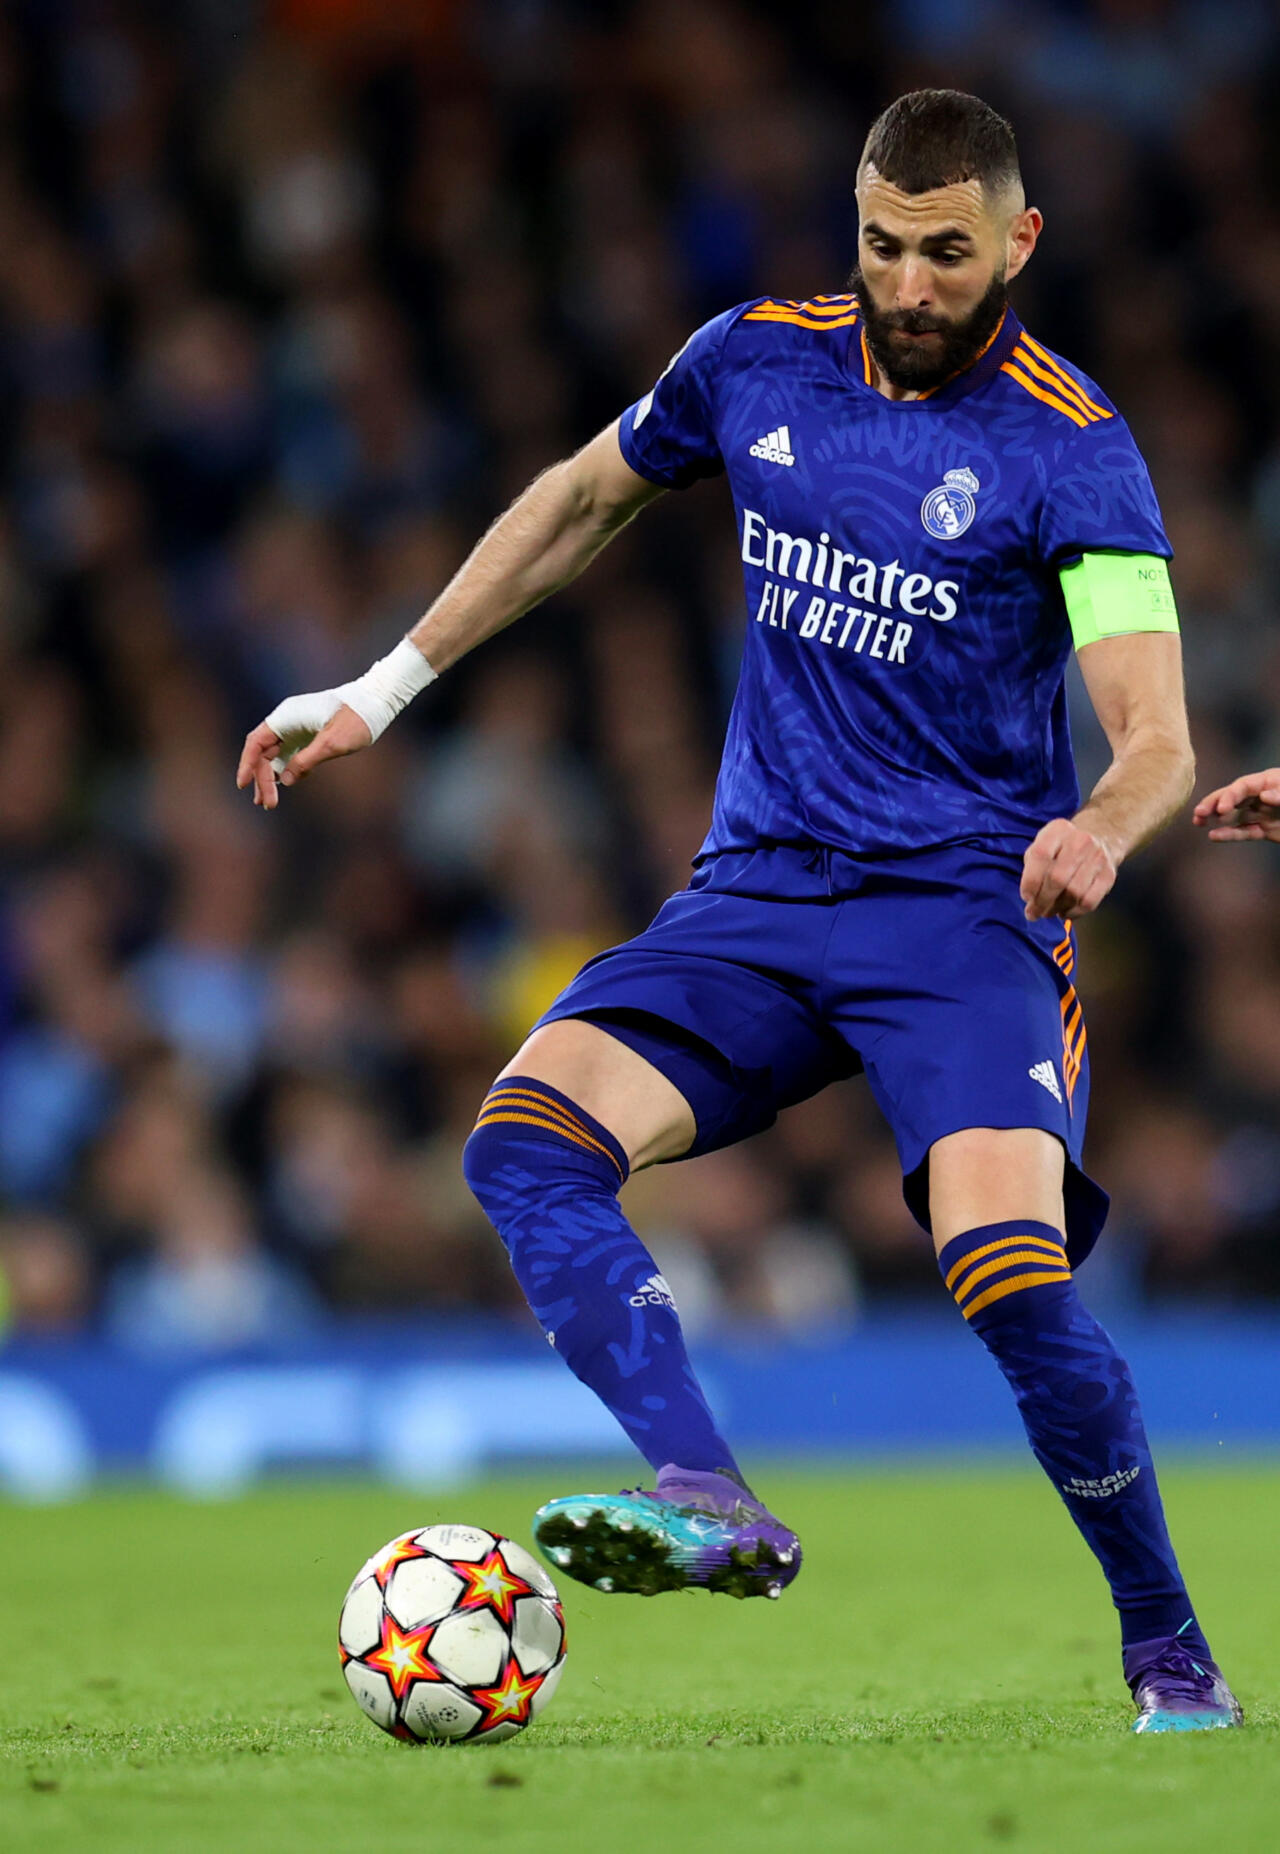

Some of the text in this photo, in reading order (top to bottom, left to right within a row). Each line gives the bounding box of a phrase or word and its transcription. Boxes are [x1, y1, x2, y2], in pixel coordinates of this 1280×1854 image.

[749, 444, 796, 467] adidas
[741, 508, 960, 622] Emirates
[756, 580, 913, 664] FLY BETTER
[1062, 1466, 1140, 1498] MADRID
[1070, 1469, 1129, 1488] REAL
